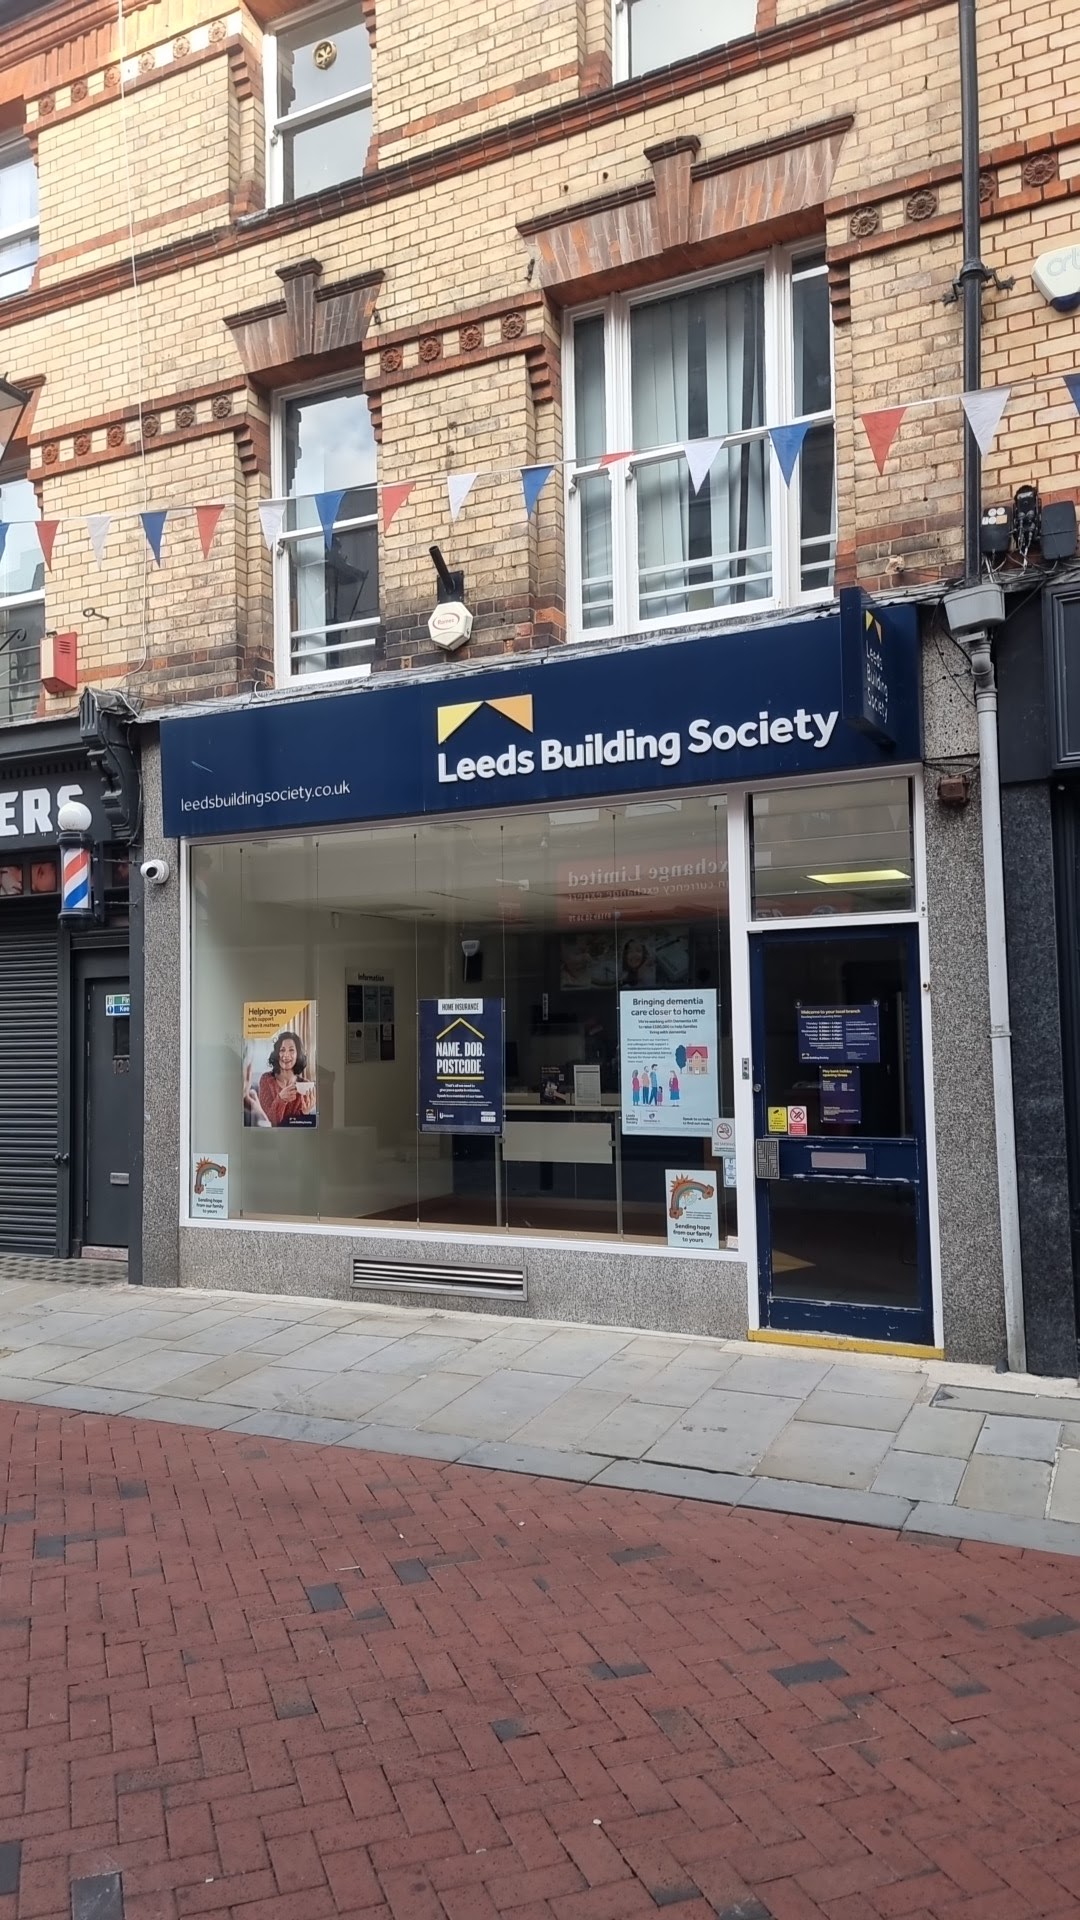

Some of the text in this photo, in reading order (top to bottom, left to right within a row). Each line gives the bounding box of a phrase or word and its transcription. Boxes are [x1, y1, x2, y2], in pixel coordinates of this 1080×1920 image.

[866, 640, 883, 671] Leeds
[866, 663, 889, 703] Building
[867, 687, 889, 724] Society
[438, 708, 839, 783] Leeds Building Society
[180, 779, 351, 812] leedsbuildingsociety.co.uk
[442, 1003, 480, 1011] HOME INSURANCE
[632, 997, 704, 1007] Bringing dementia
[248, 1008, 273, 1016] Helping
[648, 1008, 673, 1016] closer
[682, 1008, 706, 1016] home
[436, 1042, 485, 1057] NAME. DOB.
[436, 1059, 484, 1074] POSTCODE.
